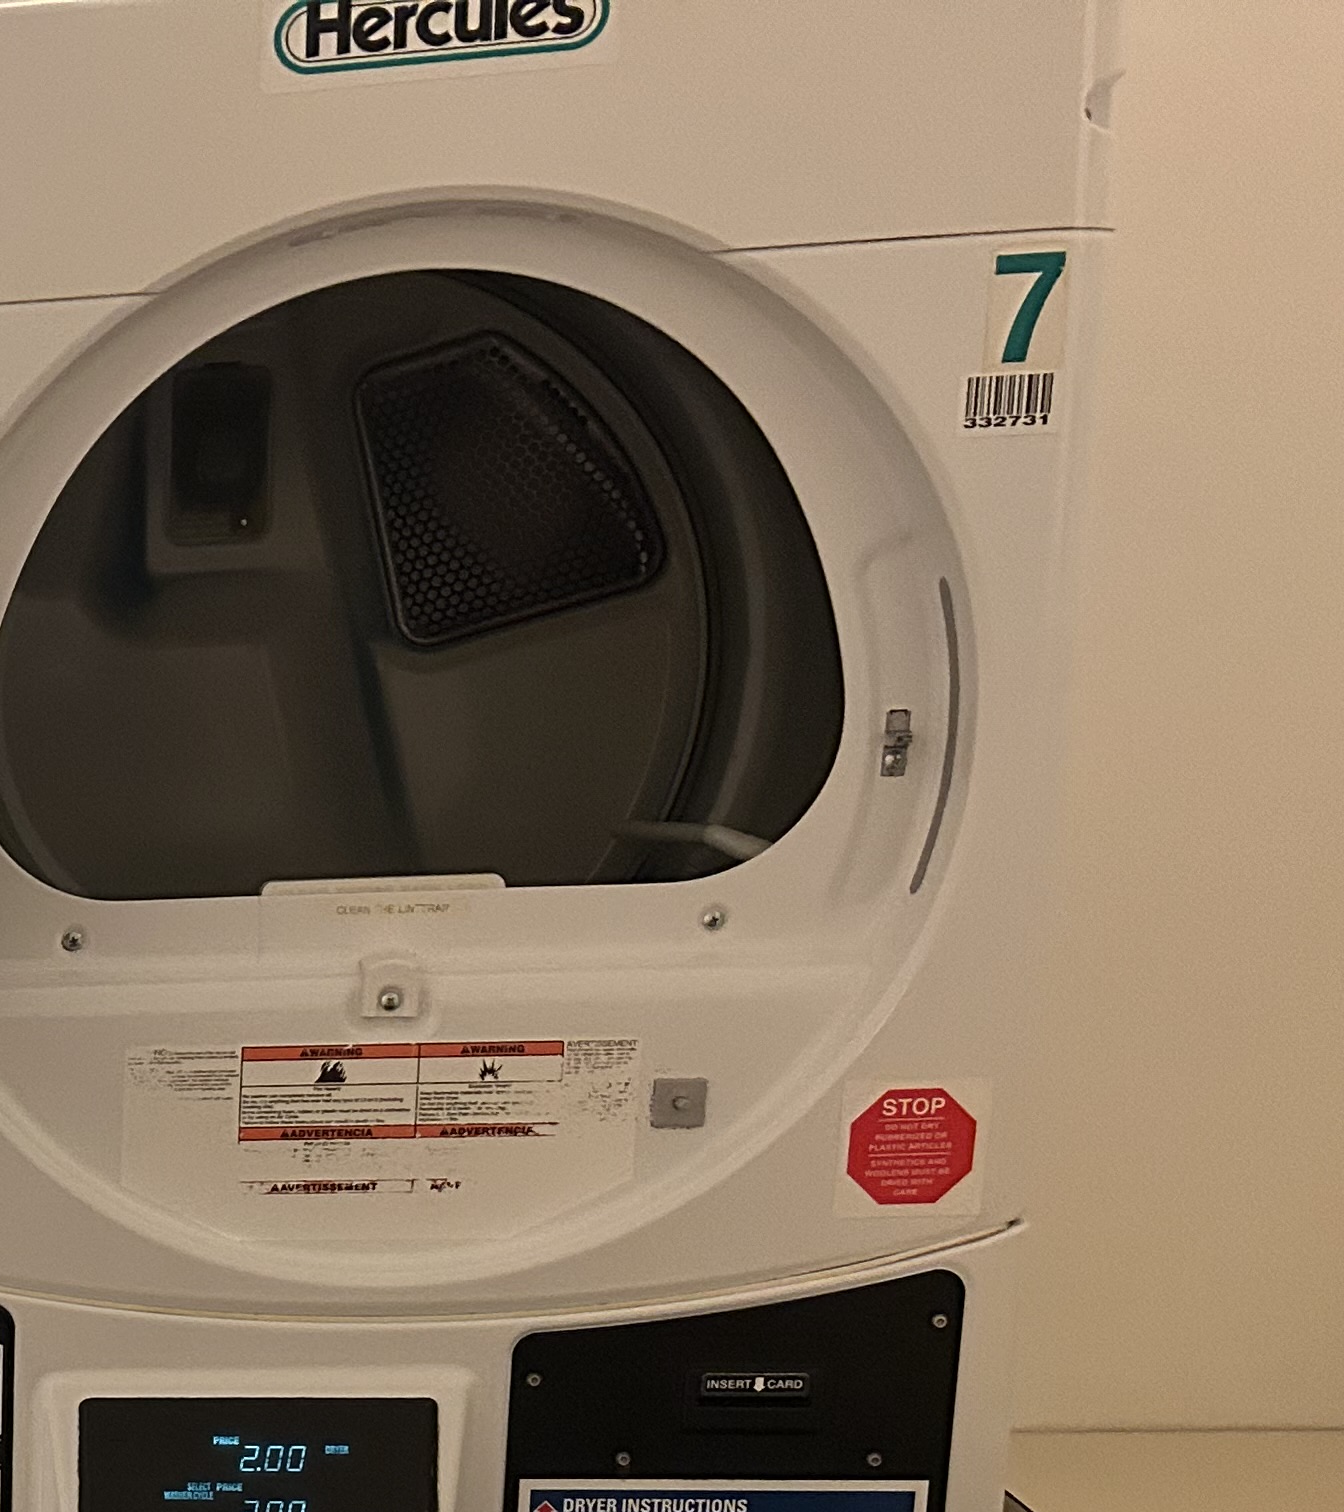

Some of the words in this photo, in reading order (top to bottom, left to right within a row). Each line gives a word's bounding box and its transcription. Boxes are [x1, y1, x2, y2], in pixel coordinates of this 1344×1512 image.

[305, 0, 586, 58] Hercules
[995, 251, 1067, 364] 7
[964, 414, 1049, 429] 332731
[470, 1044, 526, 1054] WARNING
[882, 1097, 946, 1116] STOP
[290, 1128, 373, 1138] ADVERTENCIA
[706, 1379, 752, 1389] INSERT
[767, 1379, 803, 1389] CARD
[213, 1435, 240, 1445] PRICE
[239, 1445, 307, 1472] 2.00
[187, 1482, 211, 1491] SELECT
[216, 1482, 243, 1492] PRICE
